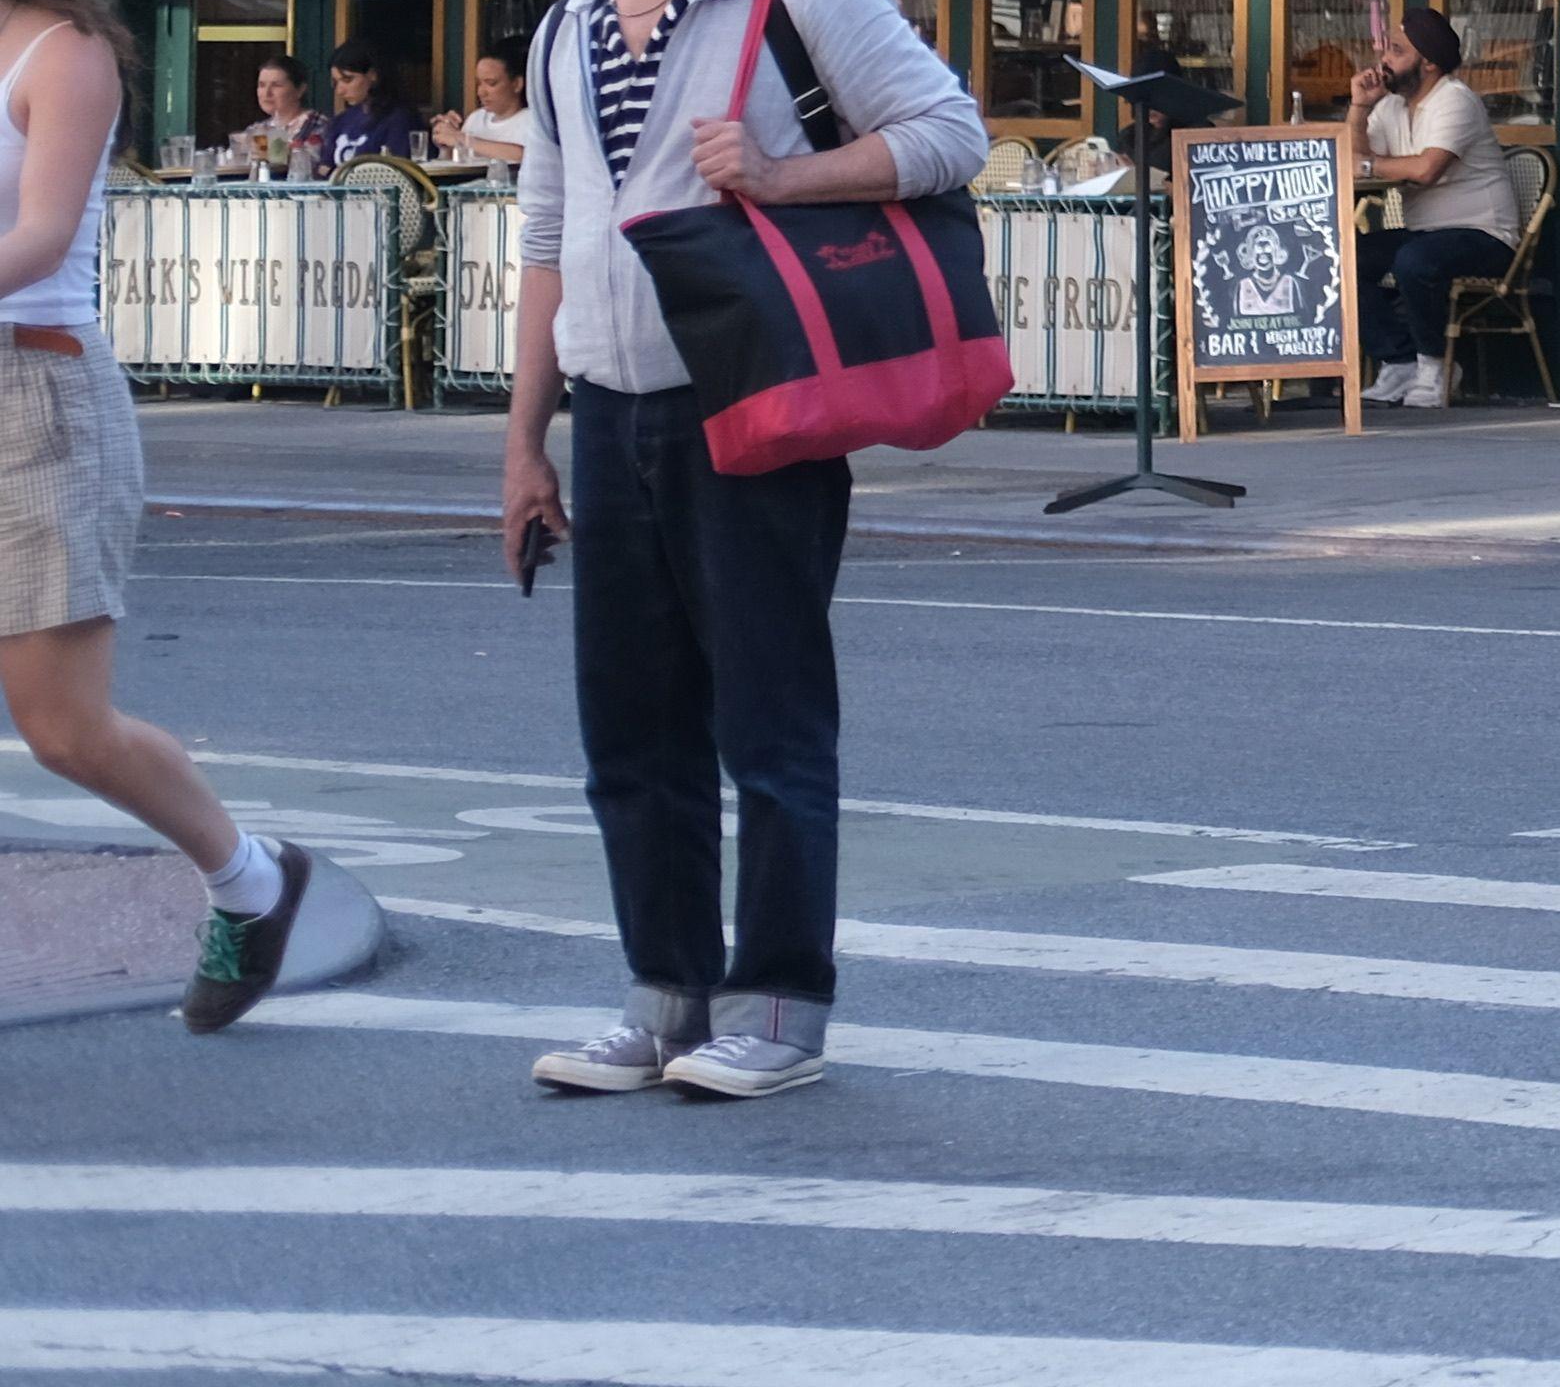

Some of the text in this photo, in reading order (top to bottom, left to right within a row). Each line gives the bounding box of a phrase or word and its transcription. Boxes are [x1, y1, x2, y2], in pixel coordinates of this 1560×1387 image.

[1241, 141, 1280, 162] WIFE
[1280, 139, 1330, 160] FREDA
[1204, 165, 1329, 209] HAPPY HOUR
[104, 256, 383, 309] JACK'S WIFE FREDA
[460, 261, 517, 313] JAC
[1042, 276, 1137, 332] FREDA
[1208, 334, 1246, 356] BAR
